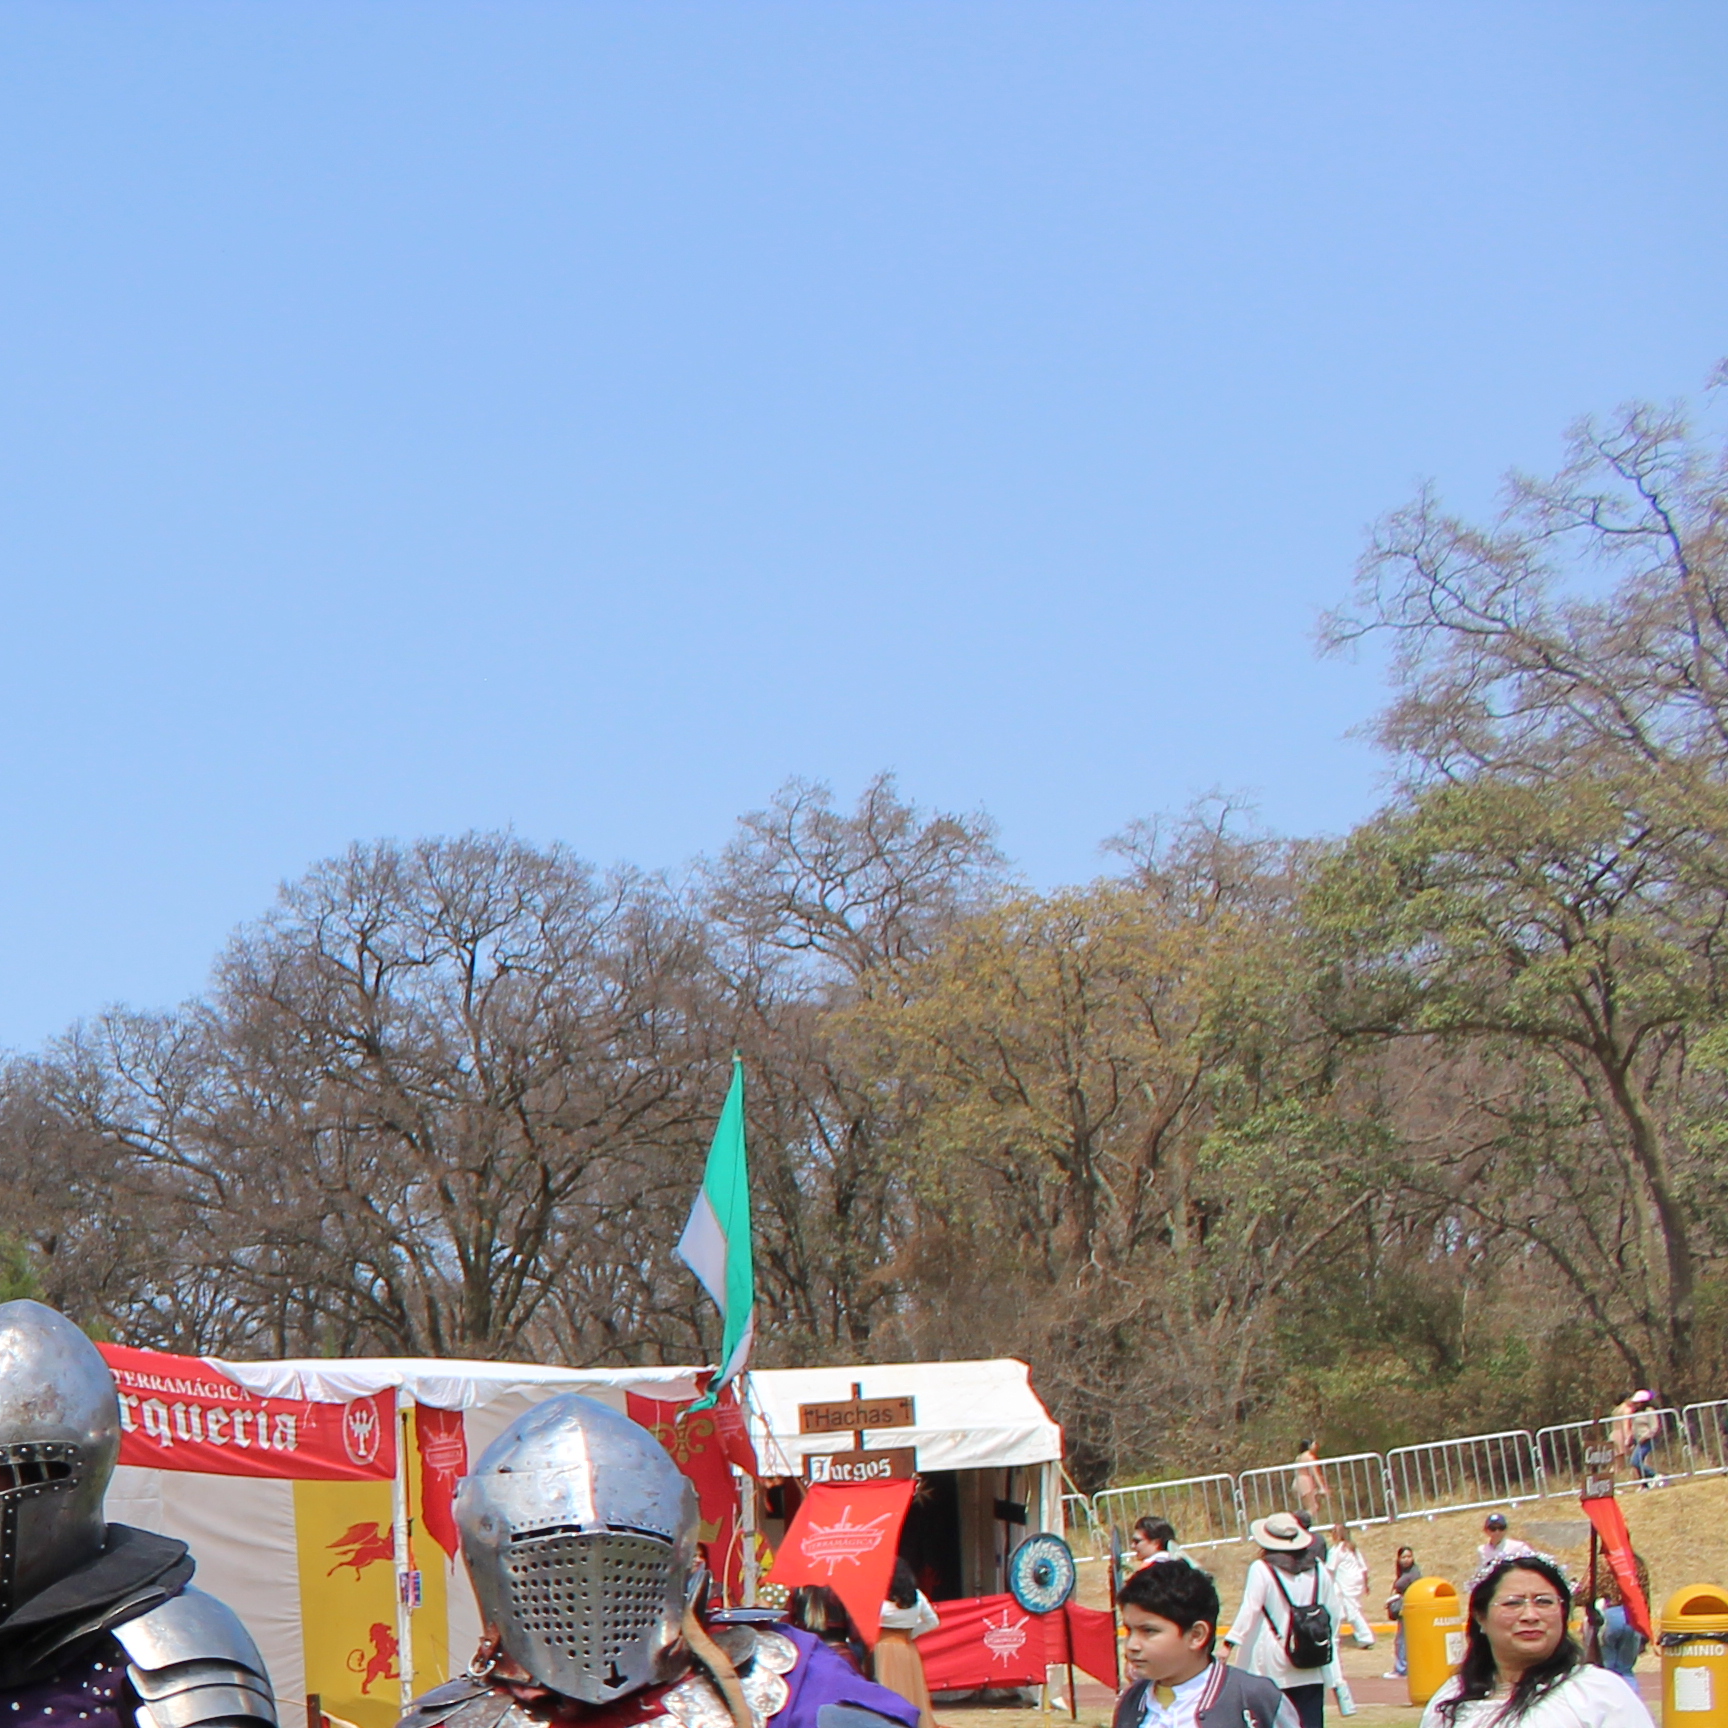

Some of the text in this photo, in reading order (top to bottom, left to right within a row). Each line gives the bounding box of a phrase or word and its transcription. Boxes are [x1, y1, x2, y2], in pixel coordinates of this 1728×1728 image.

[117, 1391, 299, 1453] rquería
[816, 1405, 893, 1427] Hachas
[810, 1455, 893, 1483] Juegos
[1663, 1644, 1725, 1657] ALUMINIO
